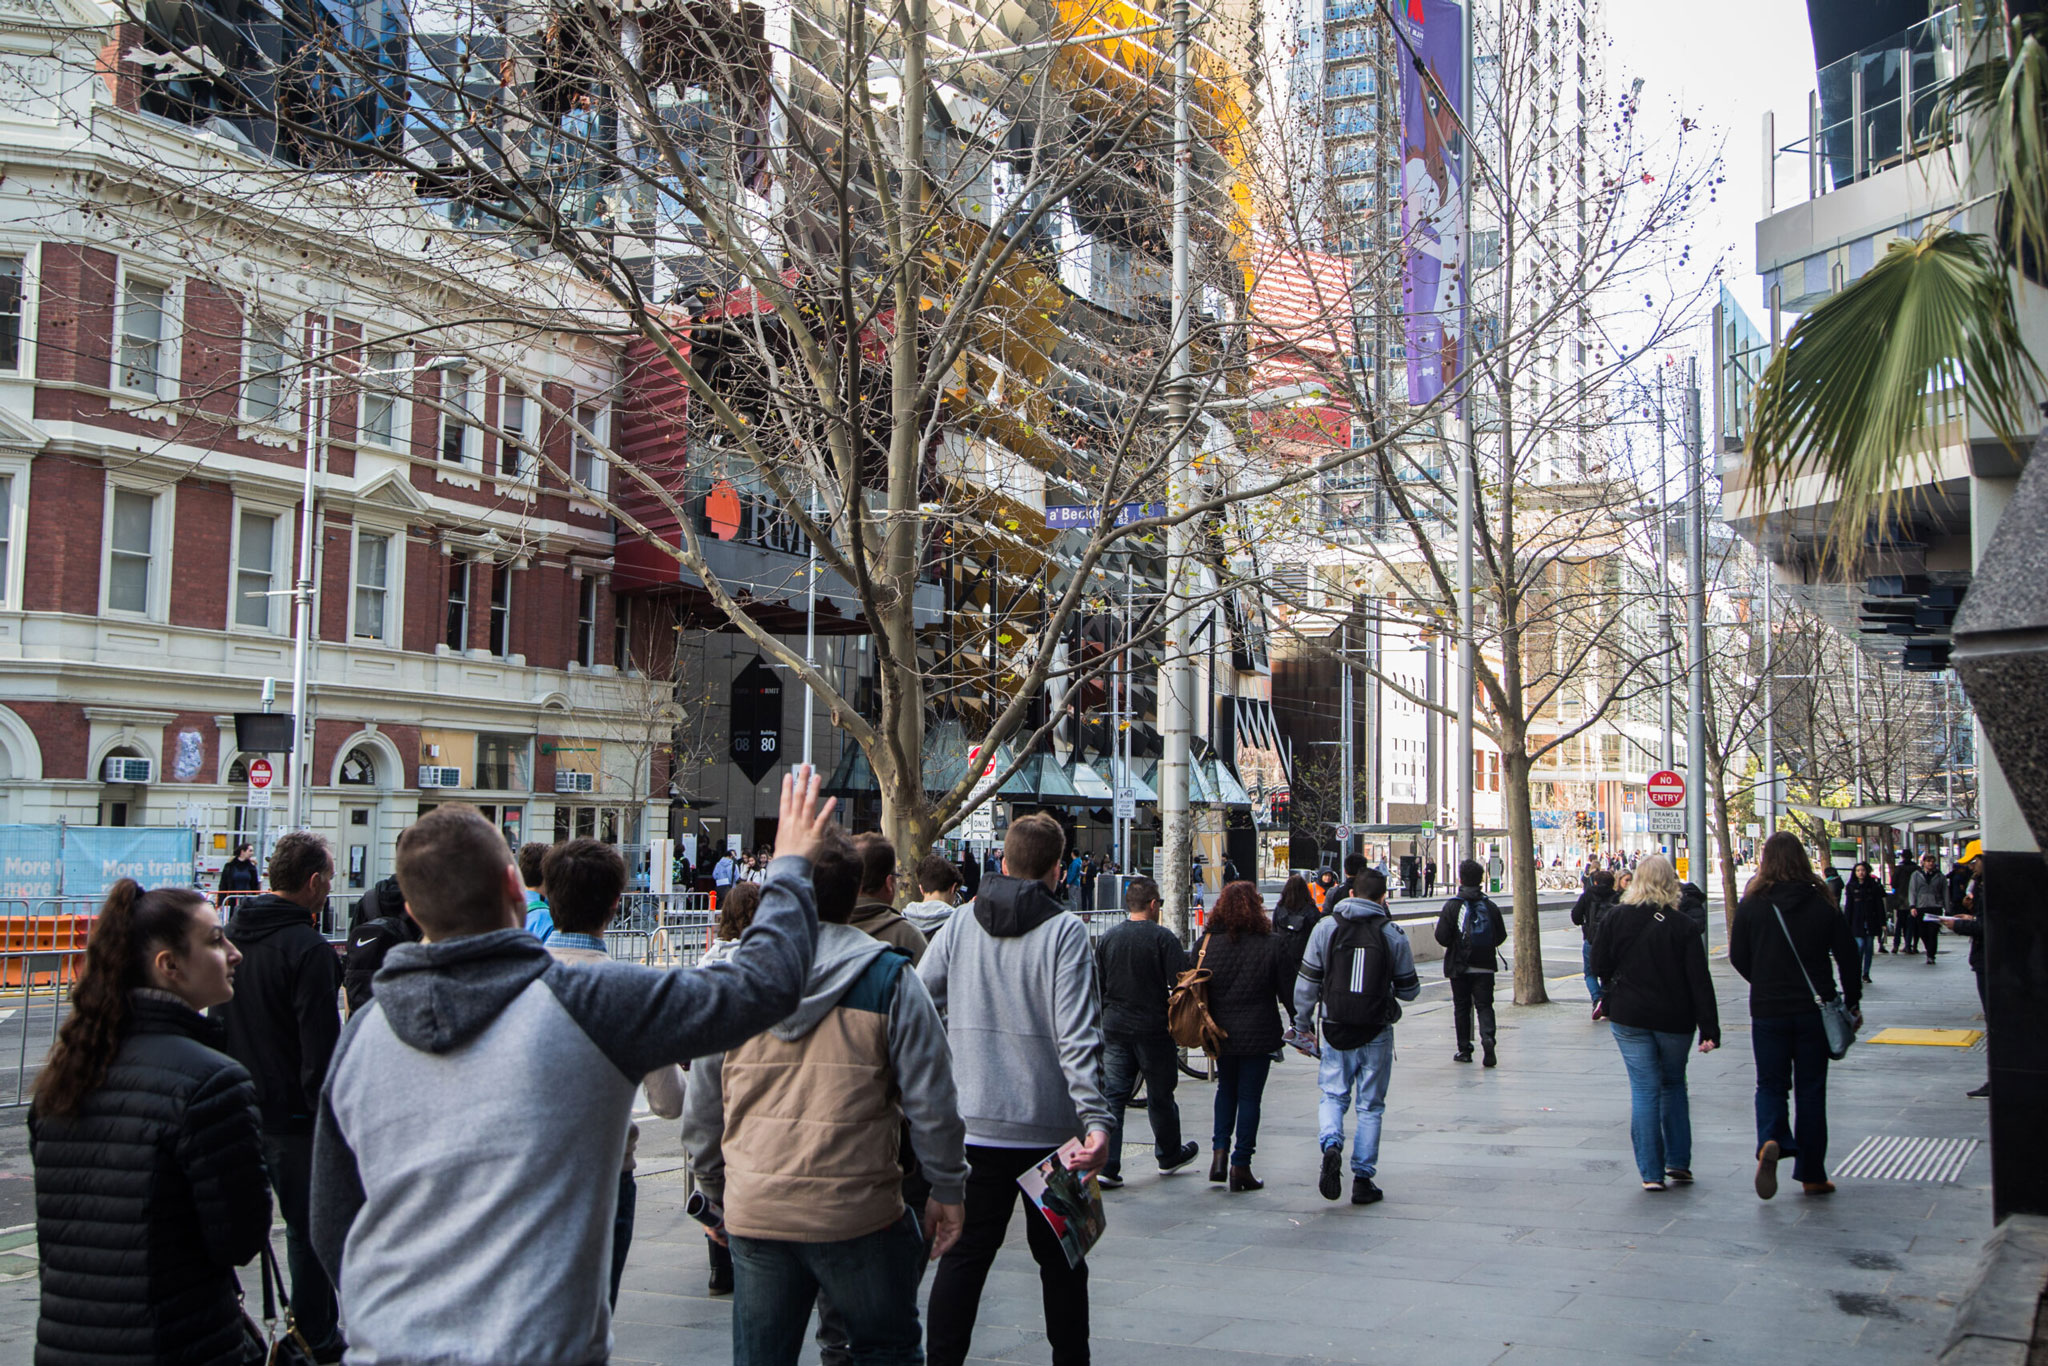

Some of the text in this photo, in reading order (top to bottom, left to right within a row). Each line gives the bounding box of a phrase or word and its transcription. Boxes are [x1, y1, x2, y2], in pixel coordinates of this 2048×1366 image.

[761, 737, 776, 752] 80
[1660, 776, 1672, 784] NO
[1652, 794, 1680, 802] ENTRY
[974, 820, 989, 828] ONLY
[5, 857, 51, 876] More
[102, 858, 192, 877] More trains
[3, 881, 50, 897] more
